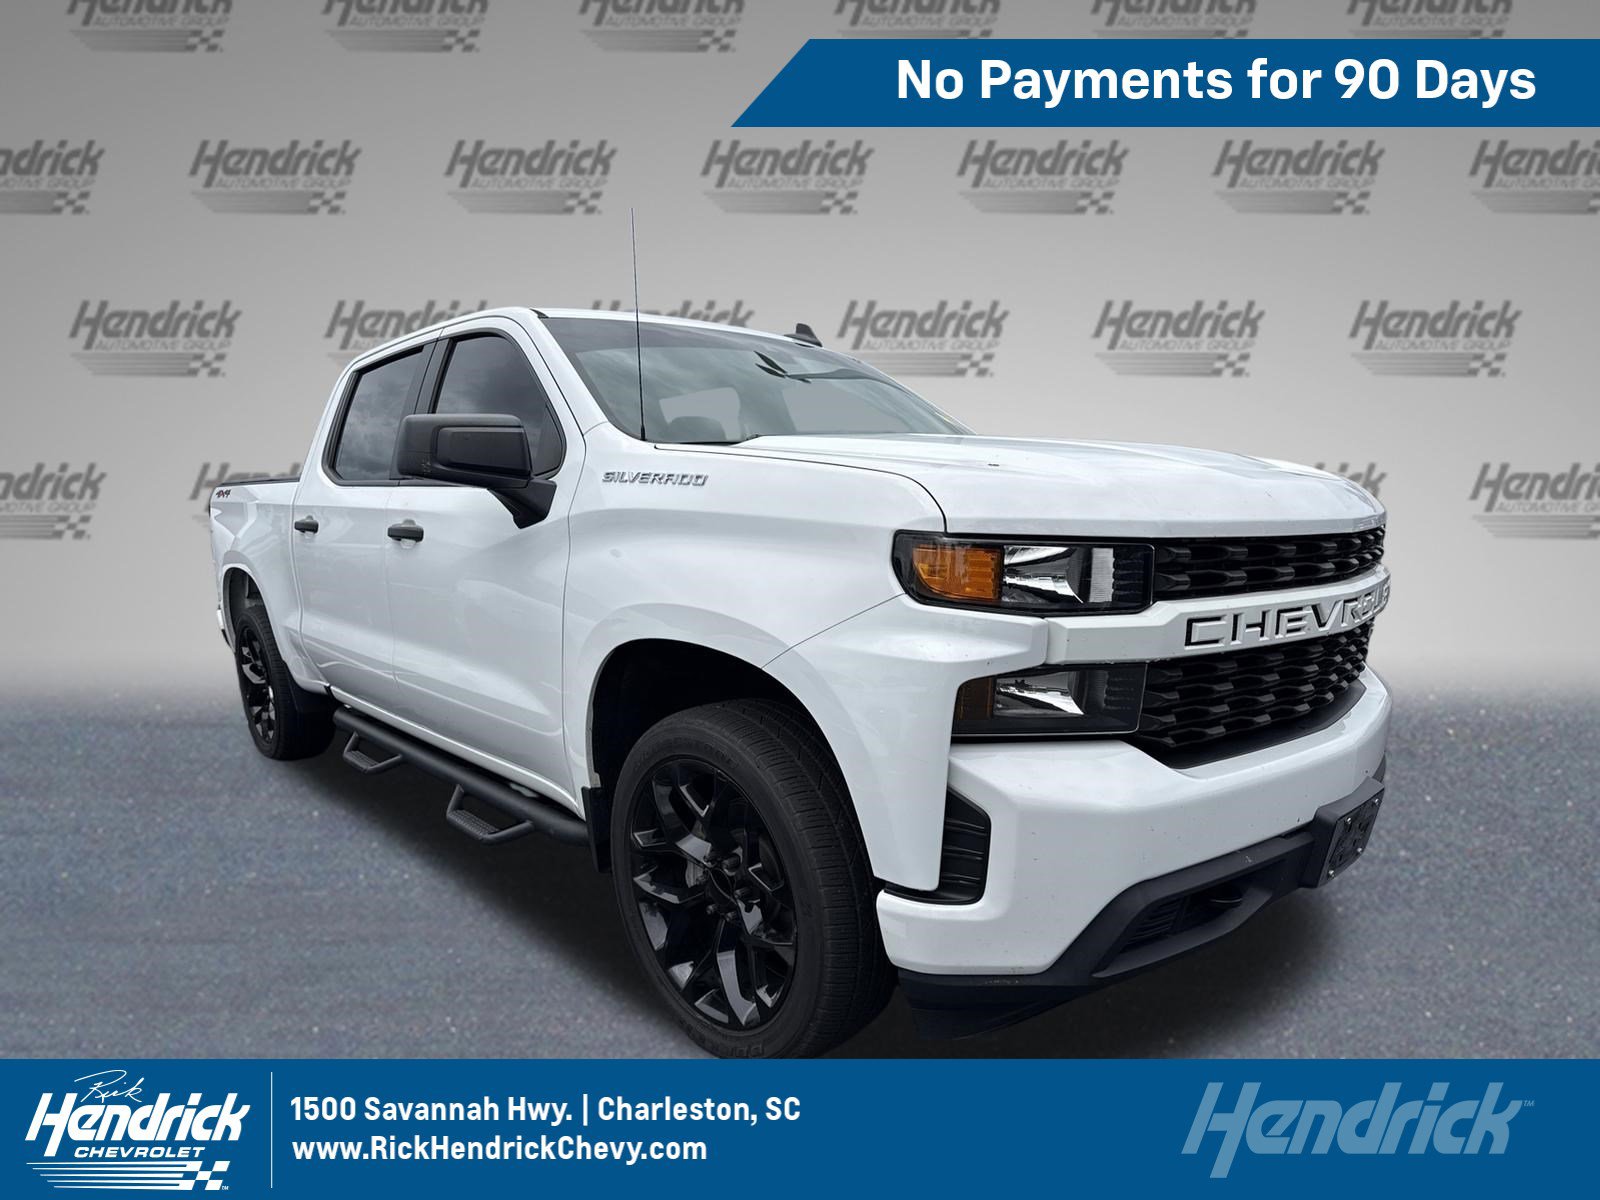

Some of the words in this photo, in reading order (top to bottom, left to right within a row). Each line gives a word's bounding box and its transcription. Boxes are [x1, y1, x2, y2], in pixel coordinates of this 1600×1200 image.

[0, 139, 105, 176] ndrick
[189, 139, 362, 189] Hendrick
[445, 139, 618, 189] Hendrick
[701, 139, 874, 189] Hendrick
[957, 139, 1130, 189] Hendrick
[1213, 139, 1386, 189] Hendrick
[1469, 139, 1600, 189] Hendri
[69, 300, 242, 350] Hendrick
[837, 300, 1010, 350] Hendrick
[1093, 300, 1266, 350] Hendrick
[1349, 300, 1522, 350] Hendrick
[0, 462, 107, 500] ndrick
[602, 471, 709, 487] SILVERADO
[1470, 462, 1600, 512] Hendri
